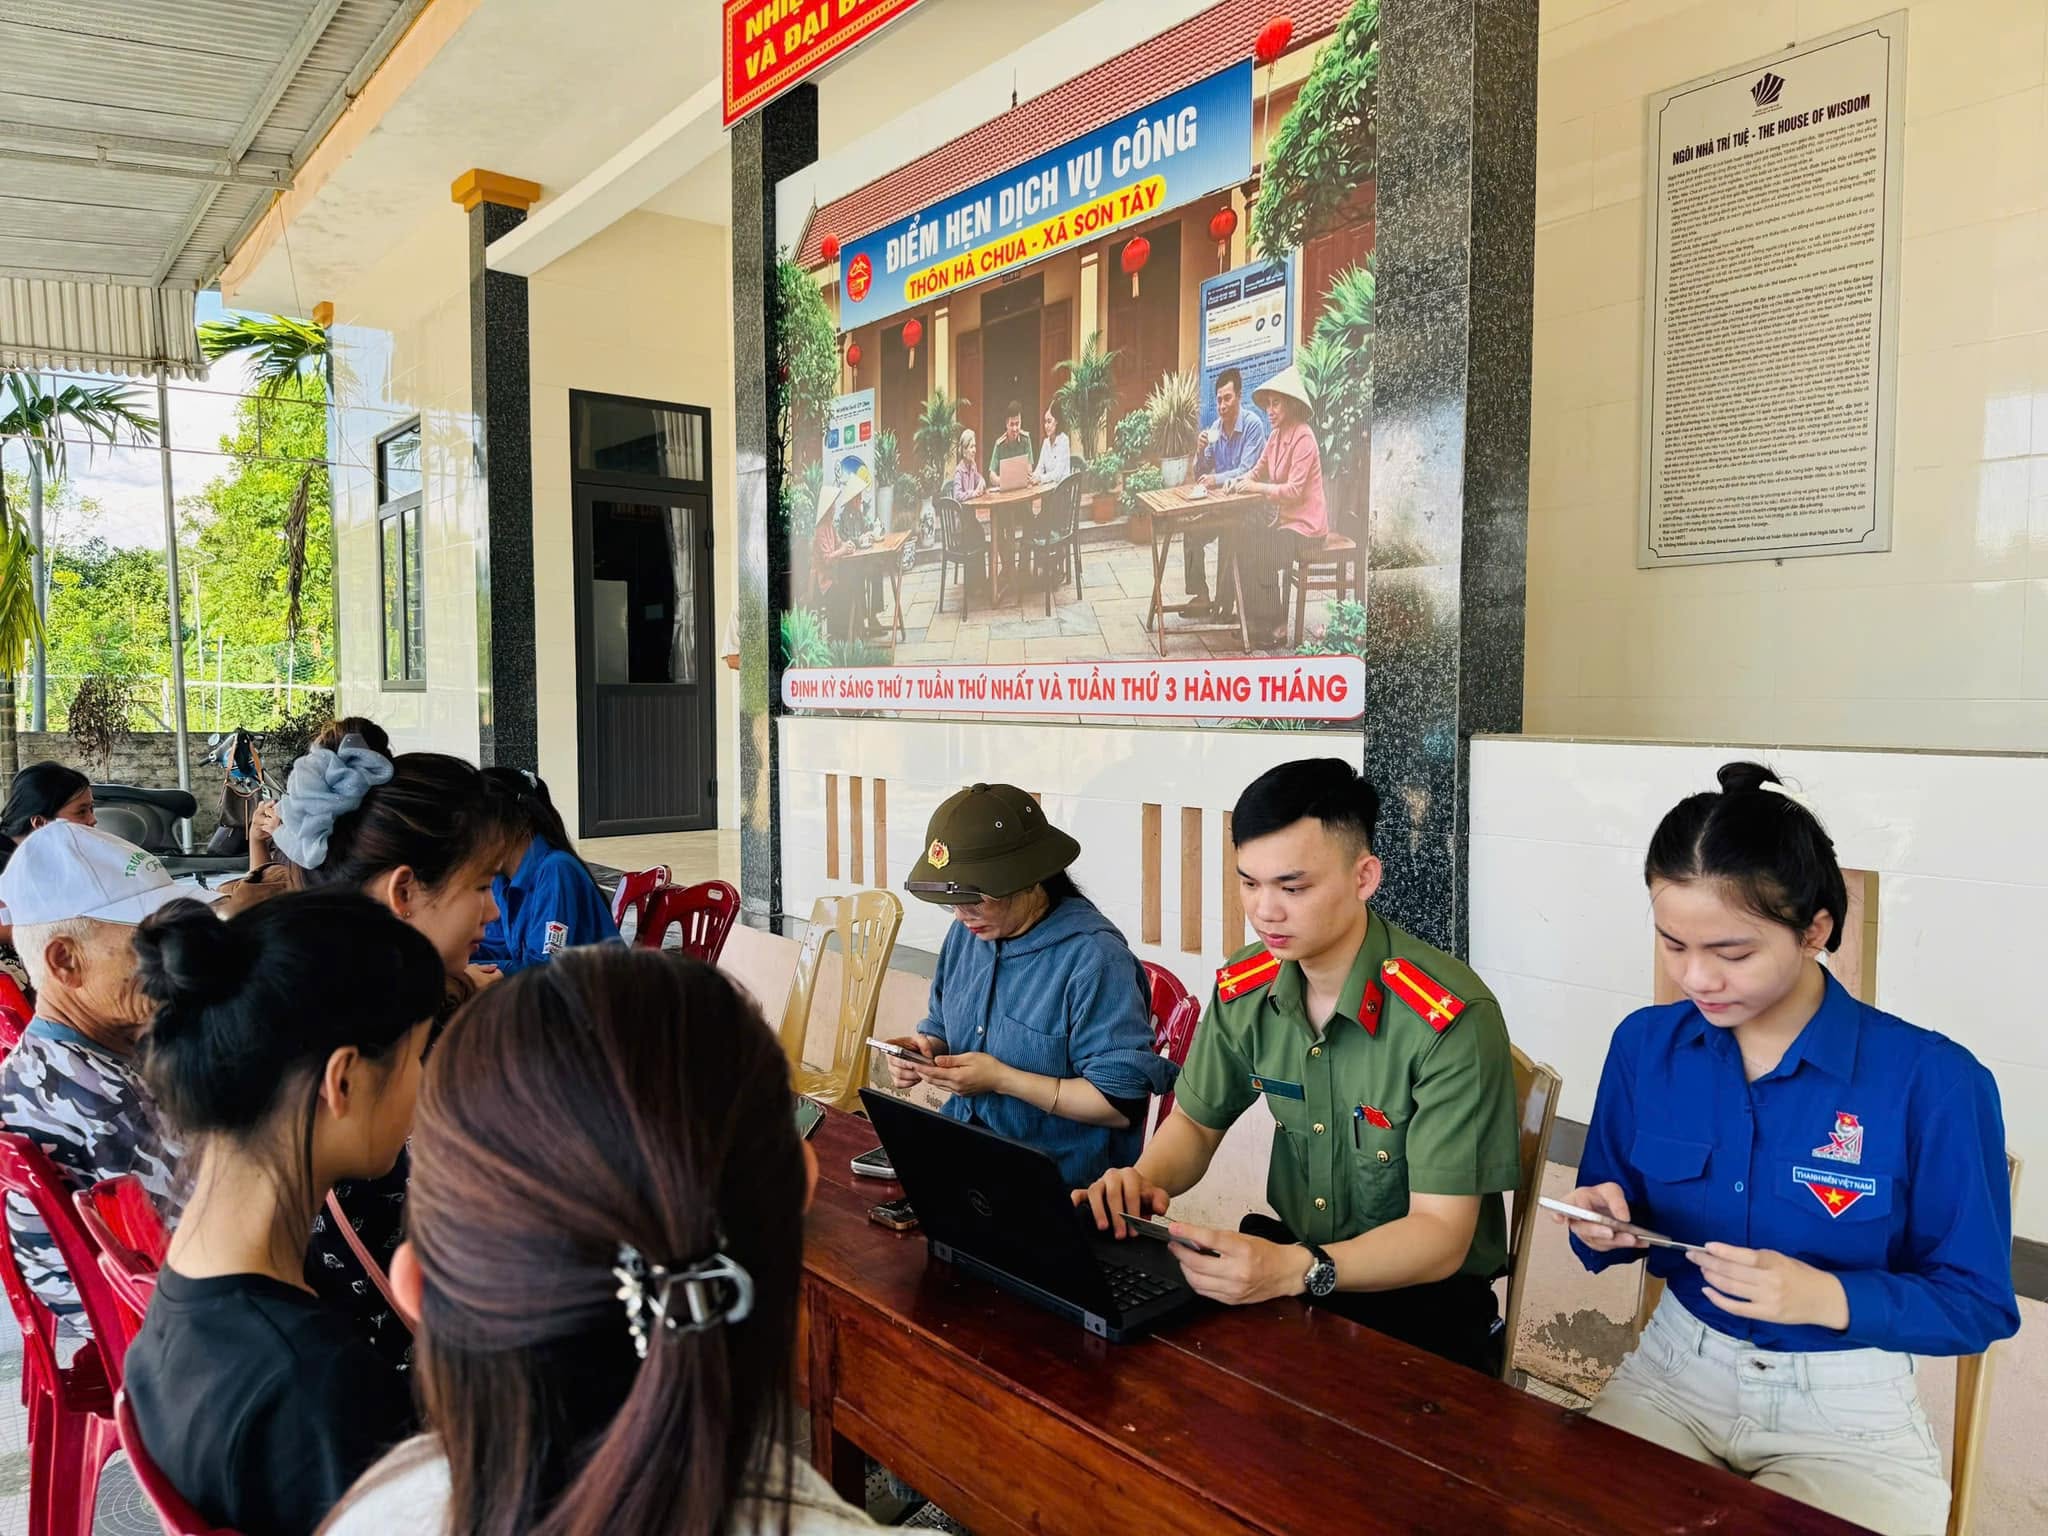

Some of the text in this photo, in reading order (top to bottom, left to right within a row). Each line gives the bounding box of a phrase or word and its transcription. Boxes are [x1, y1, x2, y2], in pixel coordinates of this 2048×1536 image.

[745, 38, 777, 80] VÀ
[784, 2, 829, 55] ĐẠI
[1673, 145, 1694, 166] NGÔI
[1696, 138, 1714, 159] NHÀ
[1717, 133, 1730, 152] TRÍ
[1733, 128, 1749, 147] TUỆ
[1758, 122, 1775, 140] THE
[1778, 112, 1809, 134] HOUSE
[1812, 107, 1825, 124] OF
[1827, 94, 1870, 119] WISDOM
[886, 106, 1197, 274] ĐIỂM HẸN DỊCH VỤ CÔNG
[910, 266, 948, 300] THÔN
[954, 253, 976, 284] HÀ
[981, 238, 1027, 272] CHUA
[1043, 217, 1068, 248] XÃ
[1074, 203, 1113, 236] SƠN
[1120, 183, 1158, 218] TÂY
[791, 666, 1347, 702] ĐỊNH KỲ SÁNG THỨ 7 TUẦN THỨ NHẤT VÀ TUẦN THỨ 3 HÀNG THÁNG
[1854, 1182, 1872, 1190] NAM
